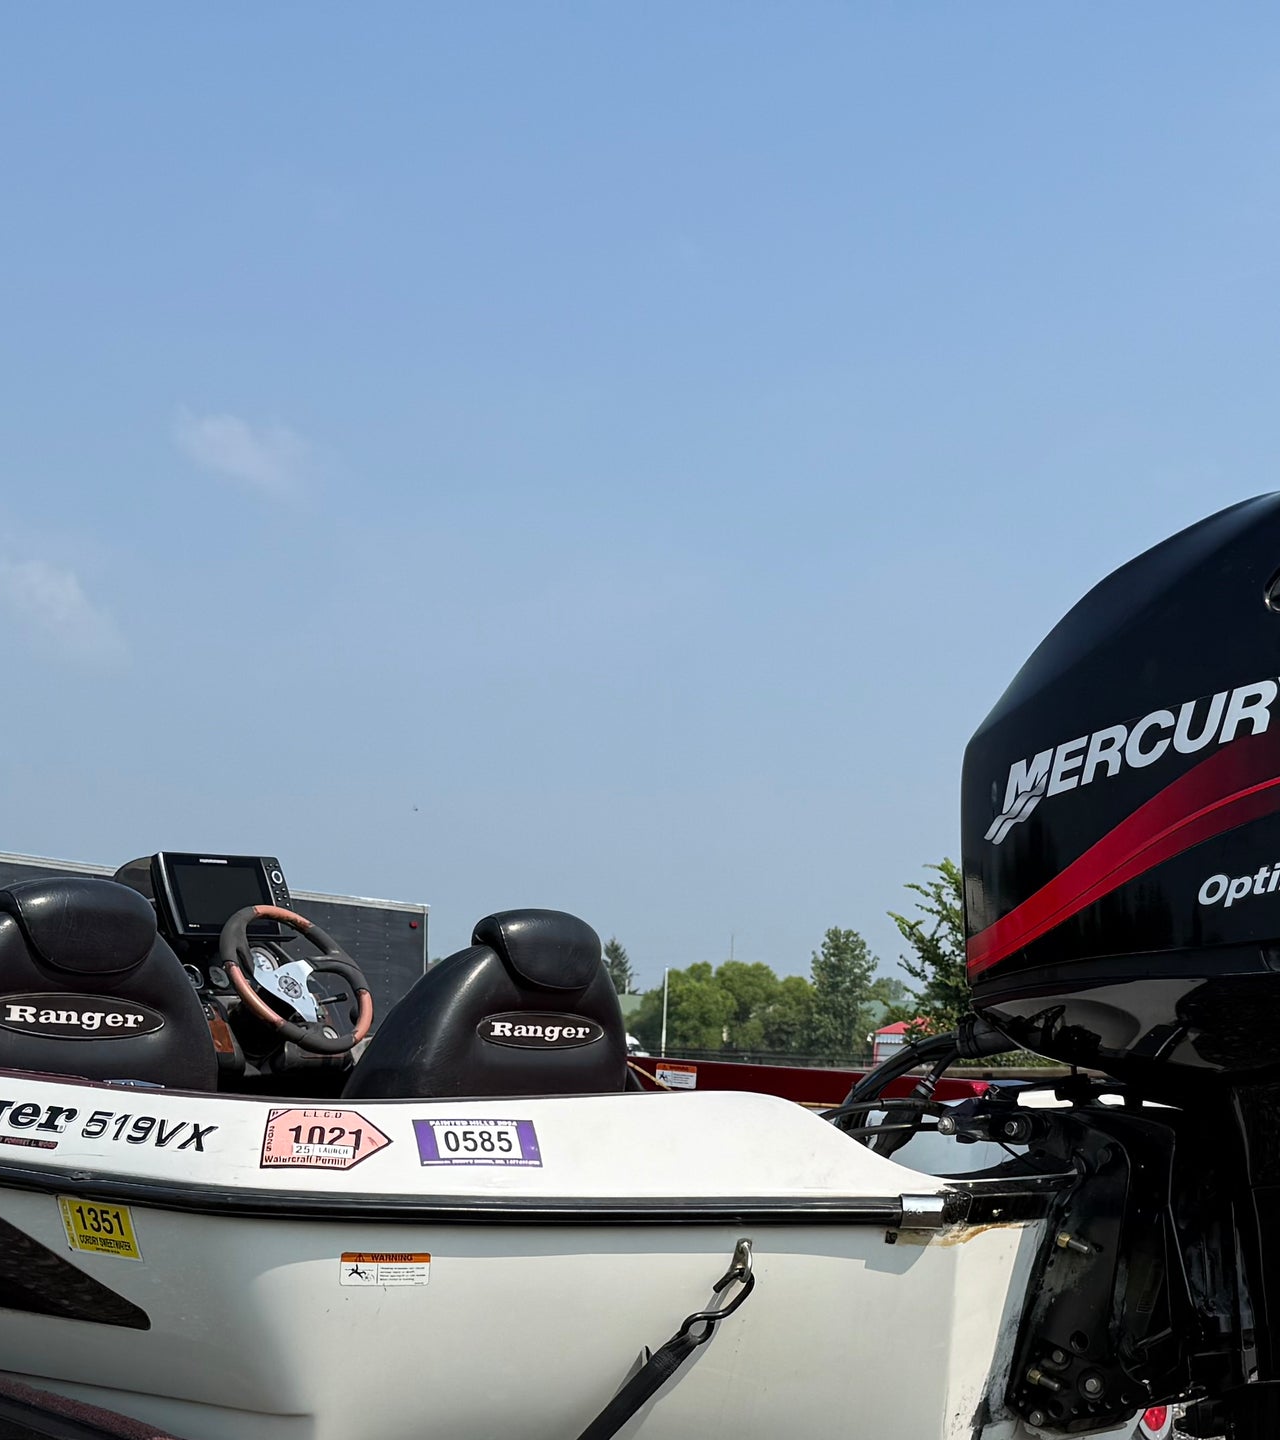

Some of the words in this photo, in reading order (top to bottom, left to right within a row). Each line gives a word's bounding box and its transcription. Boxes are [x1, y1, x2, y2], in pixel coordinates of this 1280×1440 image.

[4, 1003, 145, 1030] Ranger
[489, 1020, 591, 1042] Ranger
[82, 1110, 220, 1152] 519VX
[288, 1125, 363, 1151] 1021
[443, 1130, 514, 1153] 0585
[264, 1155, 313, 1164] Watercraft
[314, 1156, 348, 1166] Permit
[295, 1145, 311, 1154] 25
[75, 1205, 125, 1236] 1351
[370, 1253, 415, 1262] WARNING
